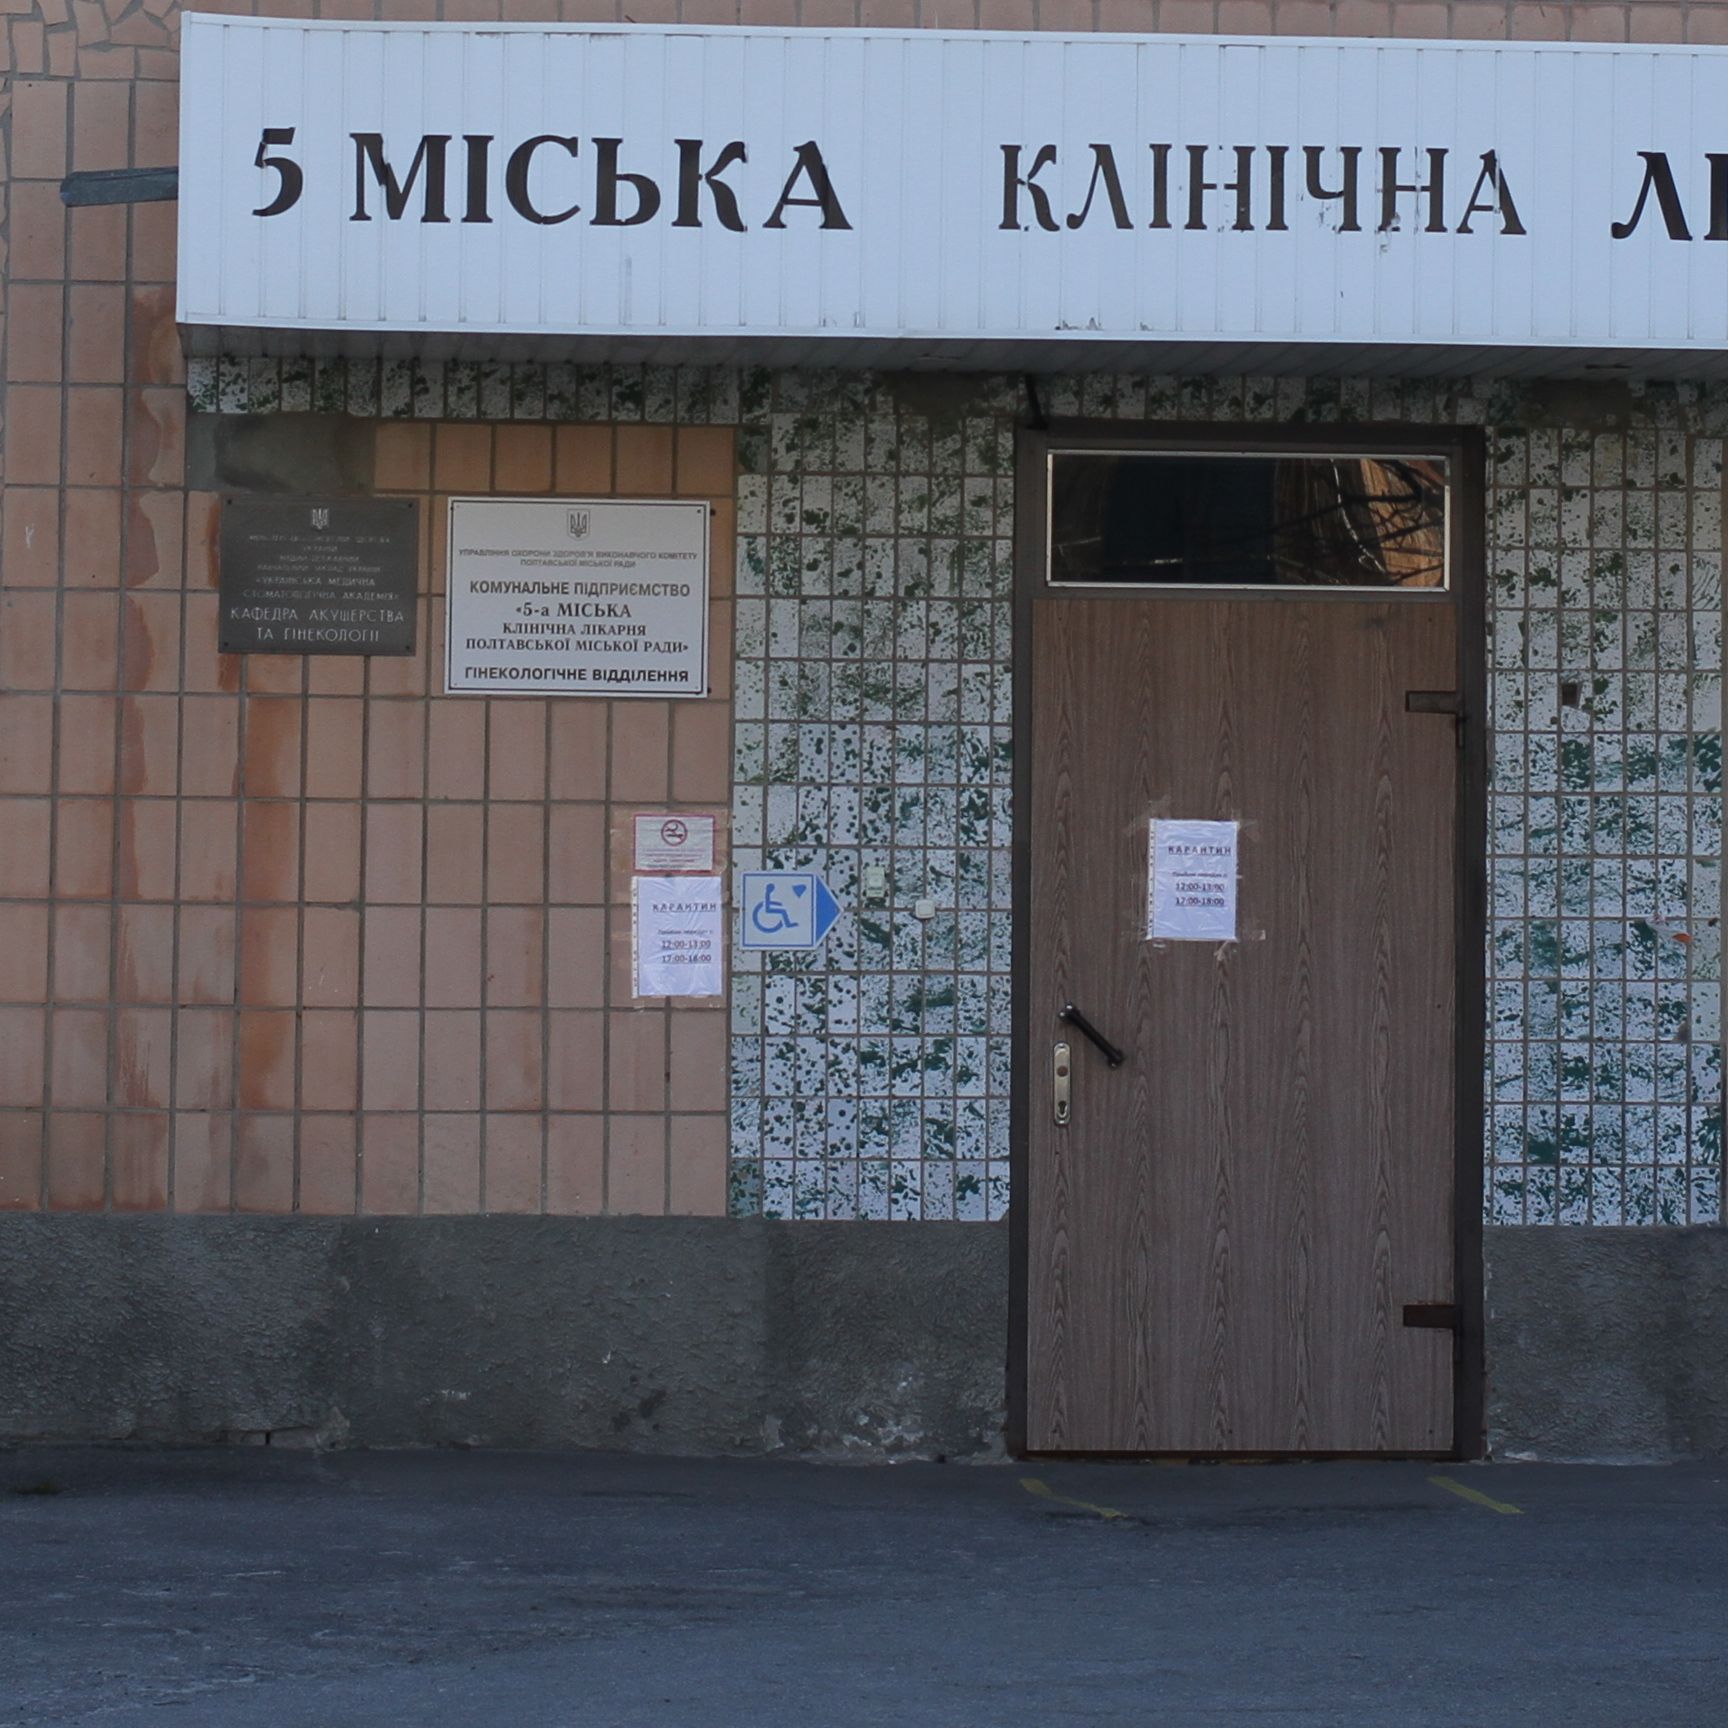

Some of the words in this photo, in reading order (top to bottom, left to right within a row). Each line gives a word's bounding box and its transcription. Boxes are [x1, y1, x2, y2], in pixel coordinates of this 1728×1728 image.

[252, 126, 304, 217] 5
[349, 131, 854, 232] МІСЬКА
[998, 143, 1528, 235] КЛІНІЧНА
[658, 552, 698, 561] КОМІТЕТУ
[614, 560, 637, 569] РАДИ
[470, 580, 569, 595] КОМУНАЛЬНЕ
[574, 582, 691, 598] ПІДПРИЄМСТВО
[231, 607, 299, 621] КАФЕДРА
[309, 608, 405, 622] АКУШЕРСТВА
[557, 603, 632, 619] МІСЬКА
[257, 627, 274, 640] ТА
[503, 623, 576, 635] КЛІНІЧНА
[581, 624, 647, 637] ЛІКАРНЯ
[466, 637, 570, 651] ПОЛТАВСЬКОЇ
[575, 638, 639, 652] МІСЬКОЇ
[644, 641, 689, 654] РАДИ»
[465, 667, 587, 681] ГІНЕКОЛОГІЧНЕ
[592, 669, 689, 683] ВІДДІЛЕННЯ
[1168, 845, 1232, 855] КАРАНТИН
[652, 903, 717, 912] КАРАНТИН
